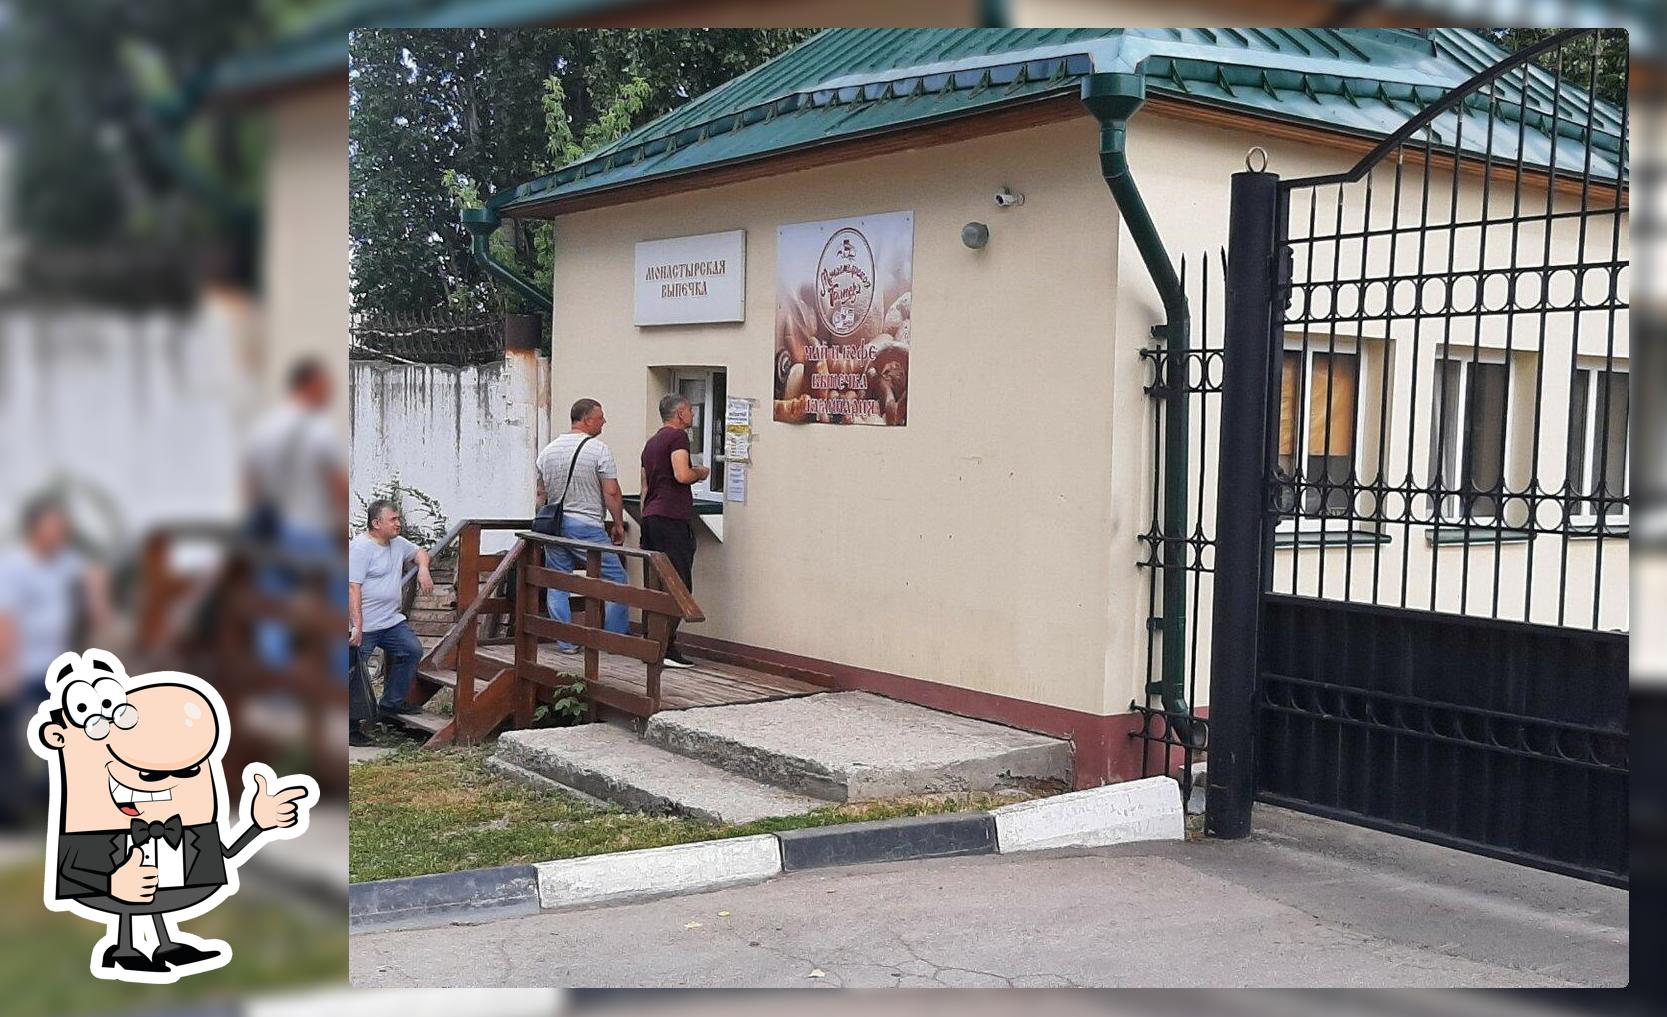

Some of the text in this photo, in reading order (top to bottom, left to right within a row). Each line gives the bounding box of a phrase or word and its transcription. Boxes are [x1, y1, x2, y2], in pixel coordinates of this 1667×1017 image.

[645, 259, 726, 281] МОНАСТЫРСКАЯ
[661, 280, 708, 298] ВЫПЕЧКА
[804, 338, 878, 366] ЧАЙ И КОФЕ
[811, 373, 868, 390] ВЫПЕЧКА
